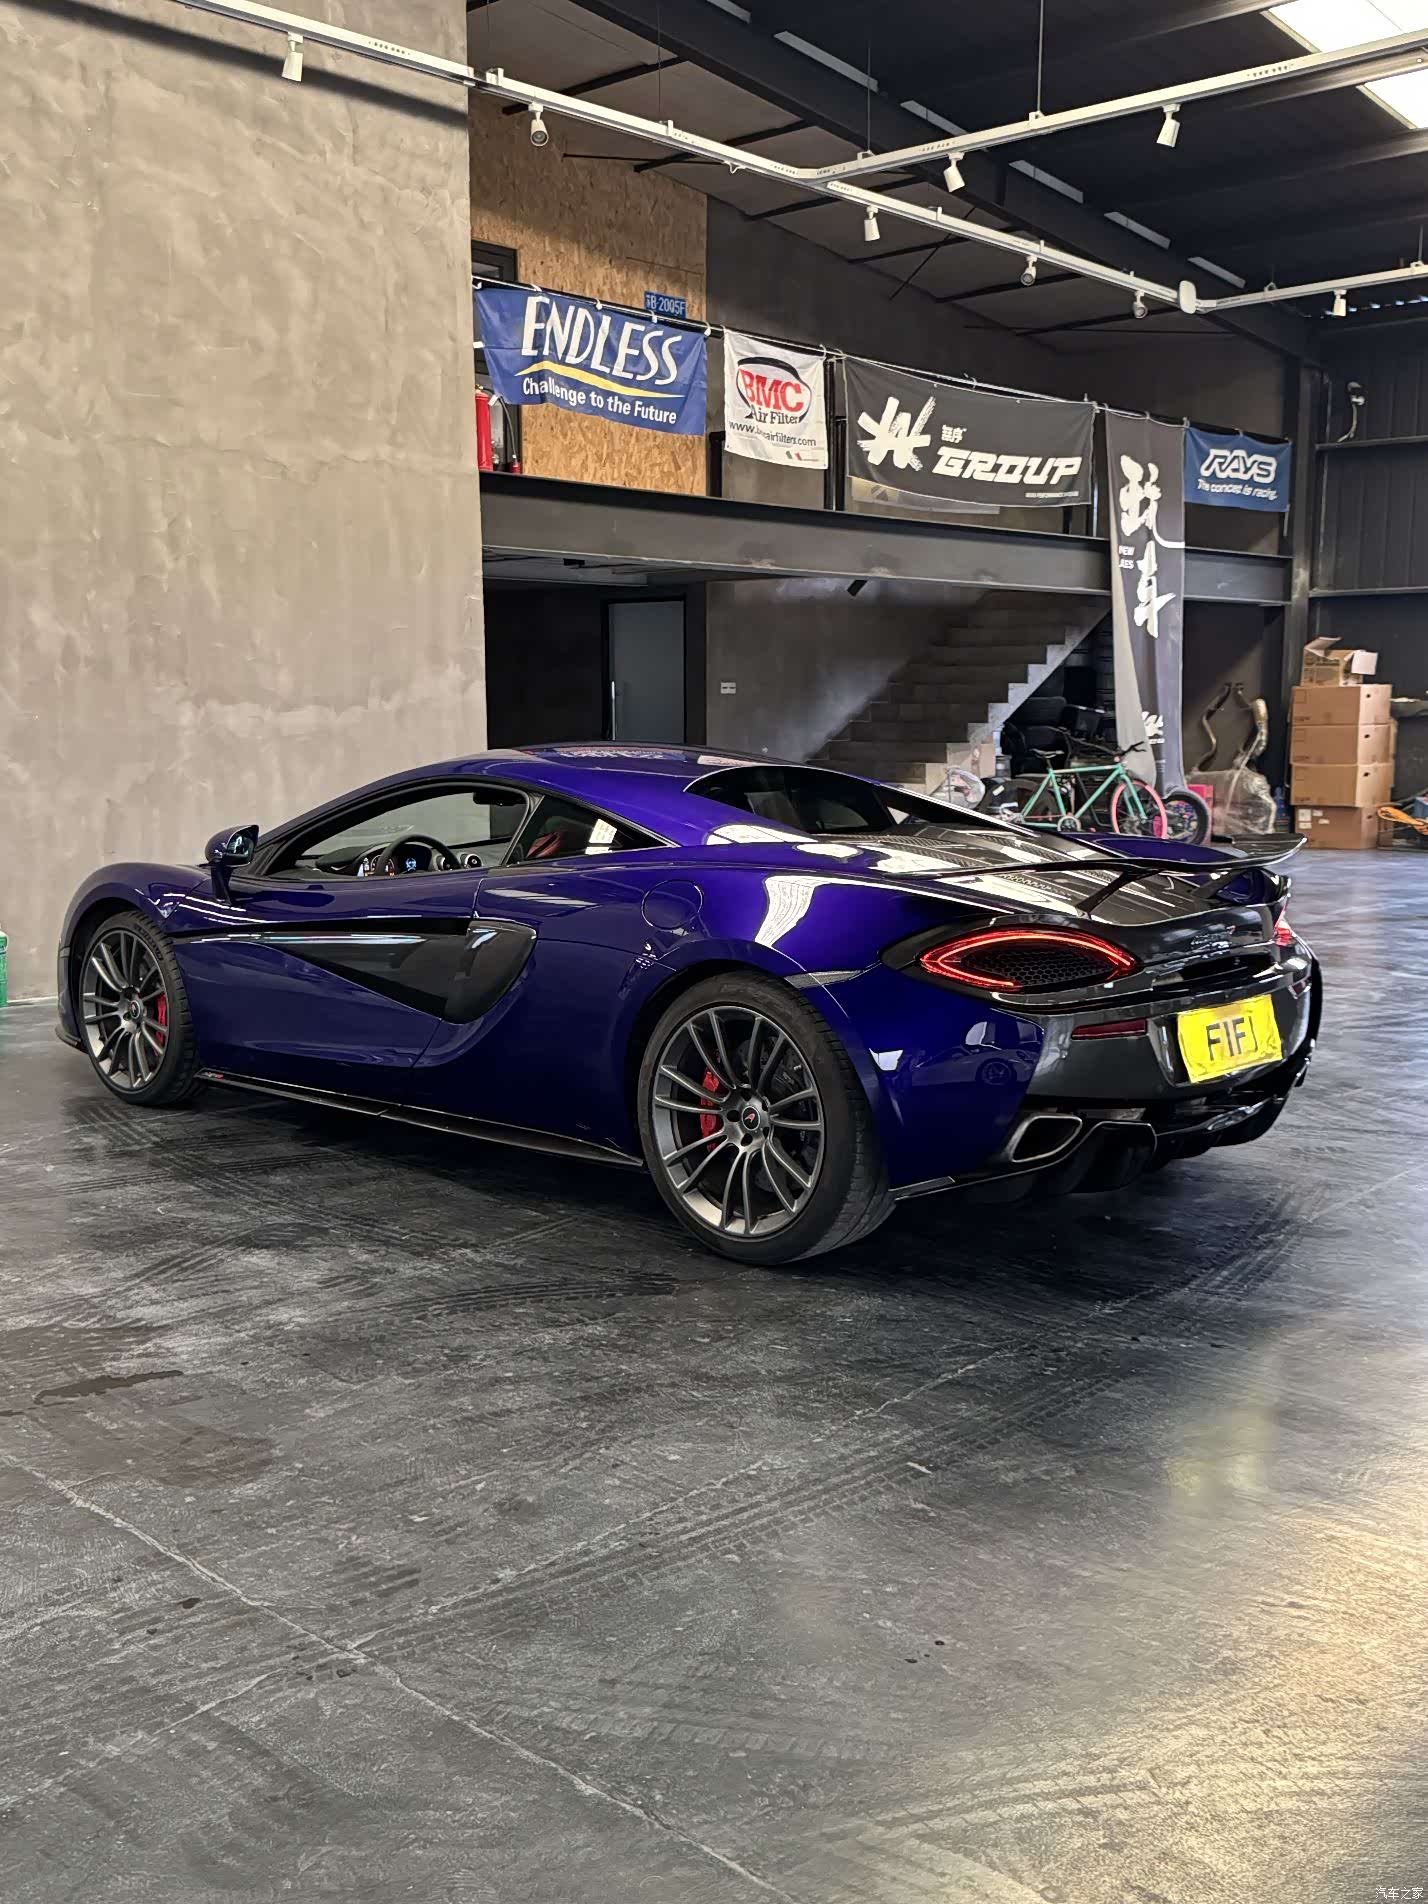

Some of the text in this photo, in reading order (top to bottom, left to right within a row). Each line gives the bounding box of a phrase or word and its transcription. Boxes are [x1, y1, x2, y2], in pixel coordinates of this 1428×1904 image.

[521, 296, 682, 386] ENDLESS
[523, 377, 677, 424] Challenge to the Future
[740, 369, 804, 412] BMC
[748, 404, 769, 423] Air
[931, 446, 1083, 485] GROUP
[1200, 449, 1277, 484] RAYS
